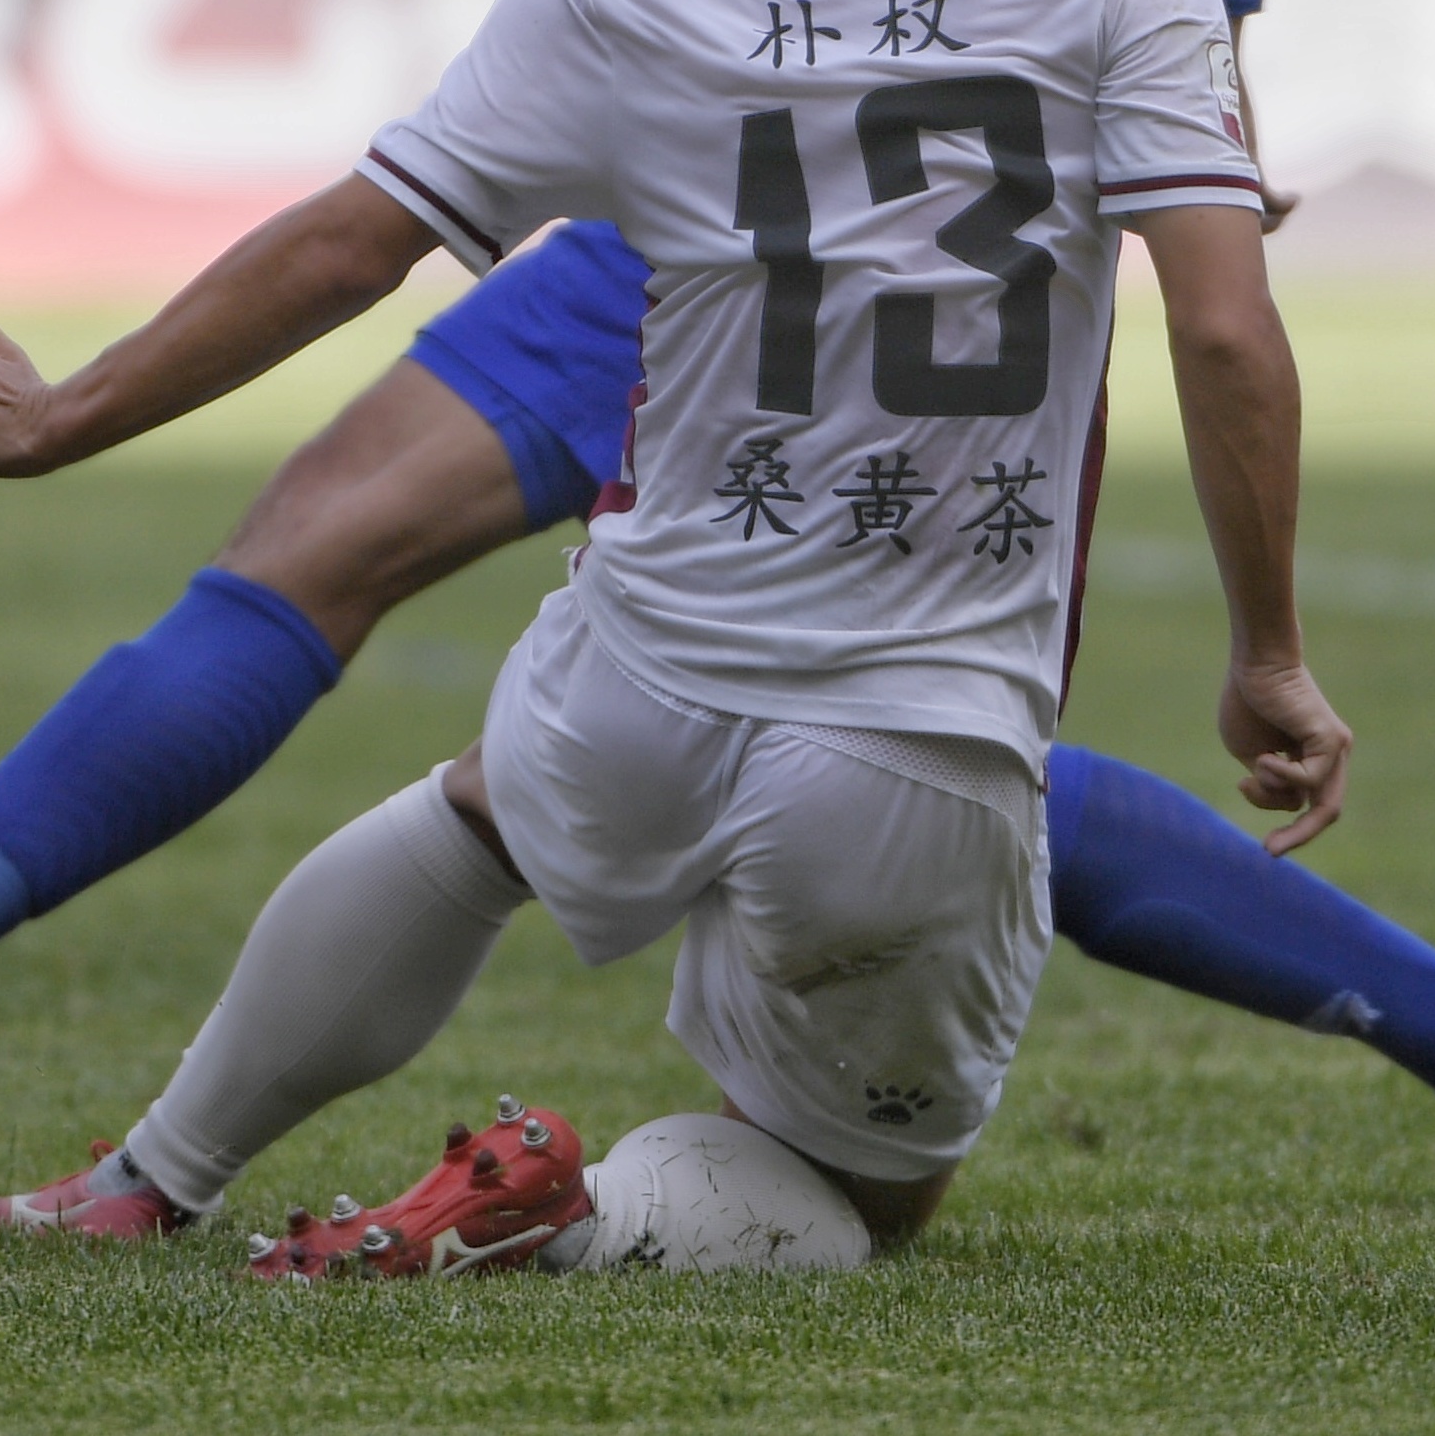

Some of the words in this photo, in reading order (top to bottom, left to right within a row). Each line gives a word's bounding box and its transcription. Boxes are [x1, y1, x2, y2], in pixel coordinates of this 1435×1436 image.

[733, 75, 1057, 417] 13
[709, 438, 1054, 564] 桑黄茶
